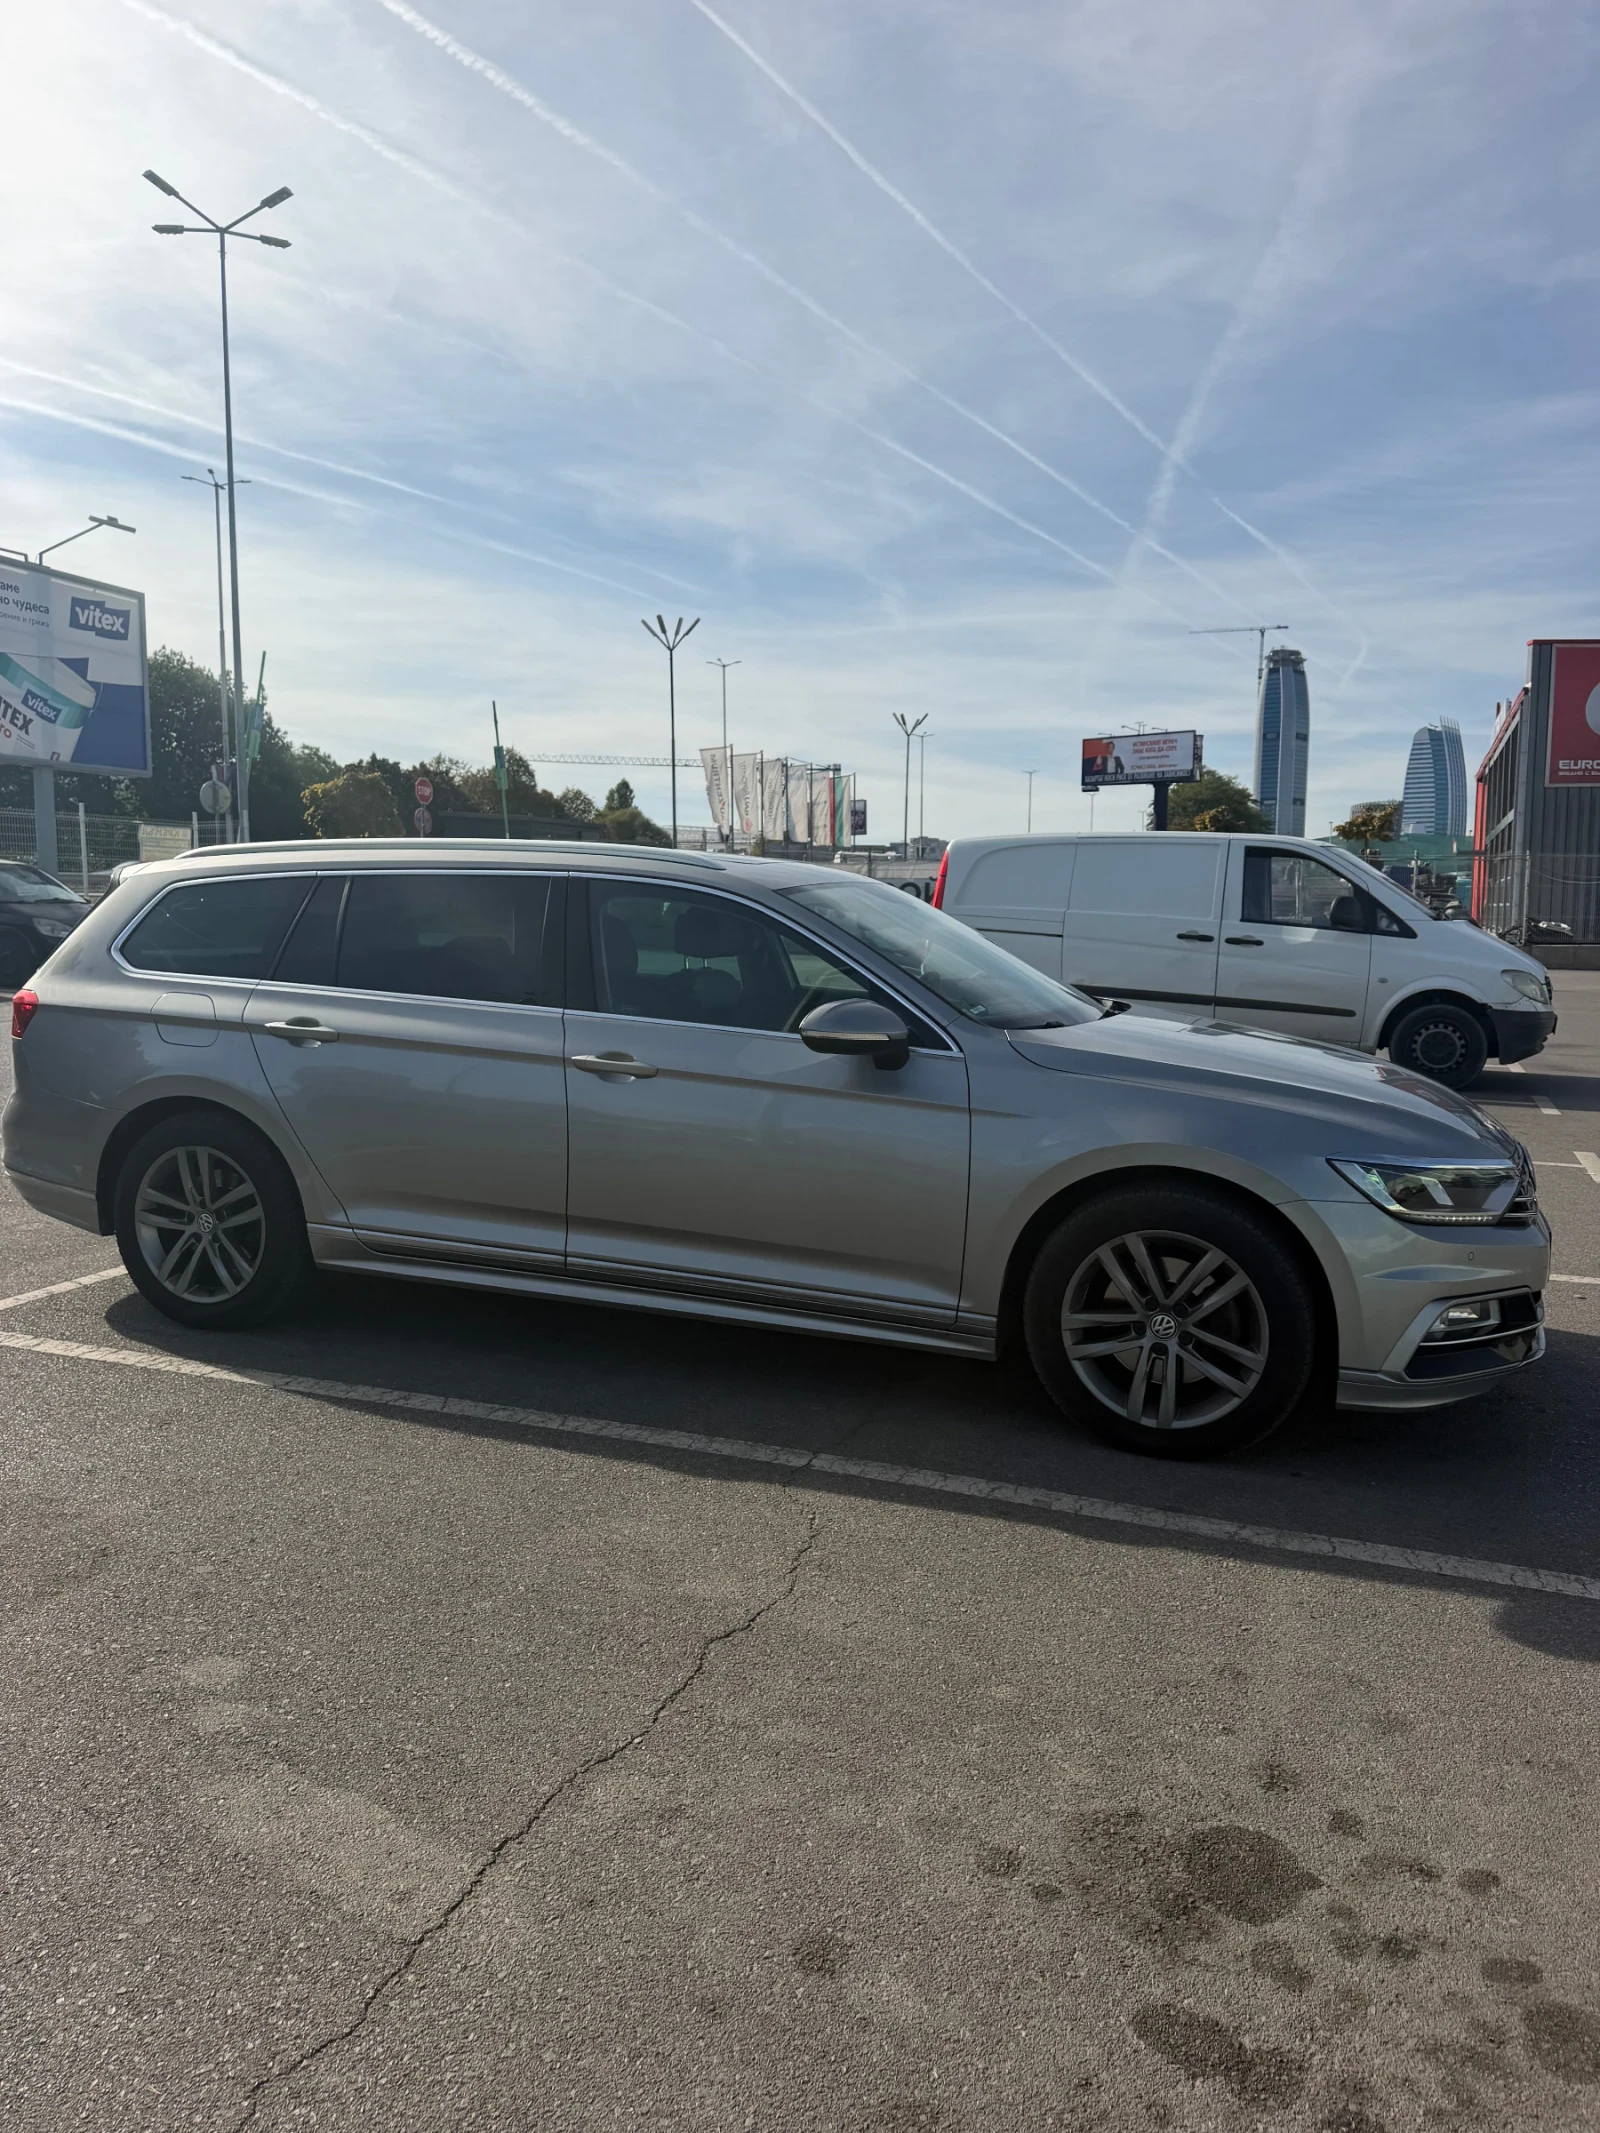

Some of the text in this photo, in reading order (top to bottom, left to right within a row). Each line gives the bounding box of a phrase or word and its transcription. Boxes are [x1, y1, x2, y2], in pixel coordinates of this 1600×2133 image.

[12, 598, 50, 615] чудеса
[28, 617, 50, 628] грижа
[75, 605, 125, 633] vitex
[26, 694, 58, 721] vitex
